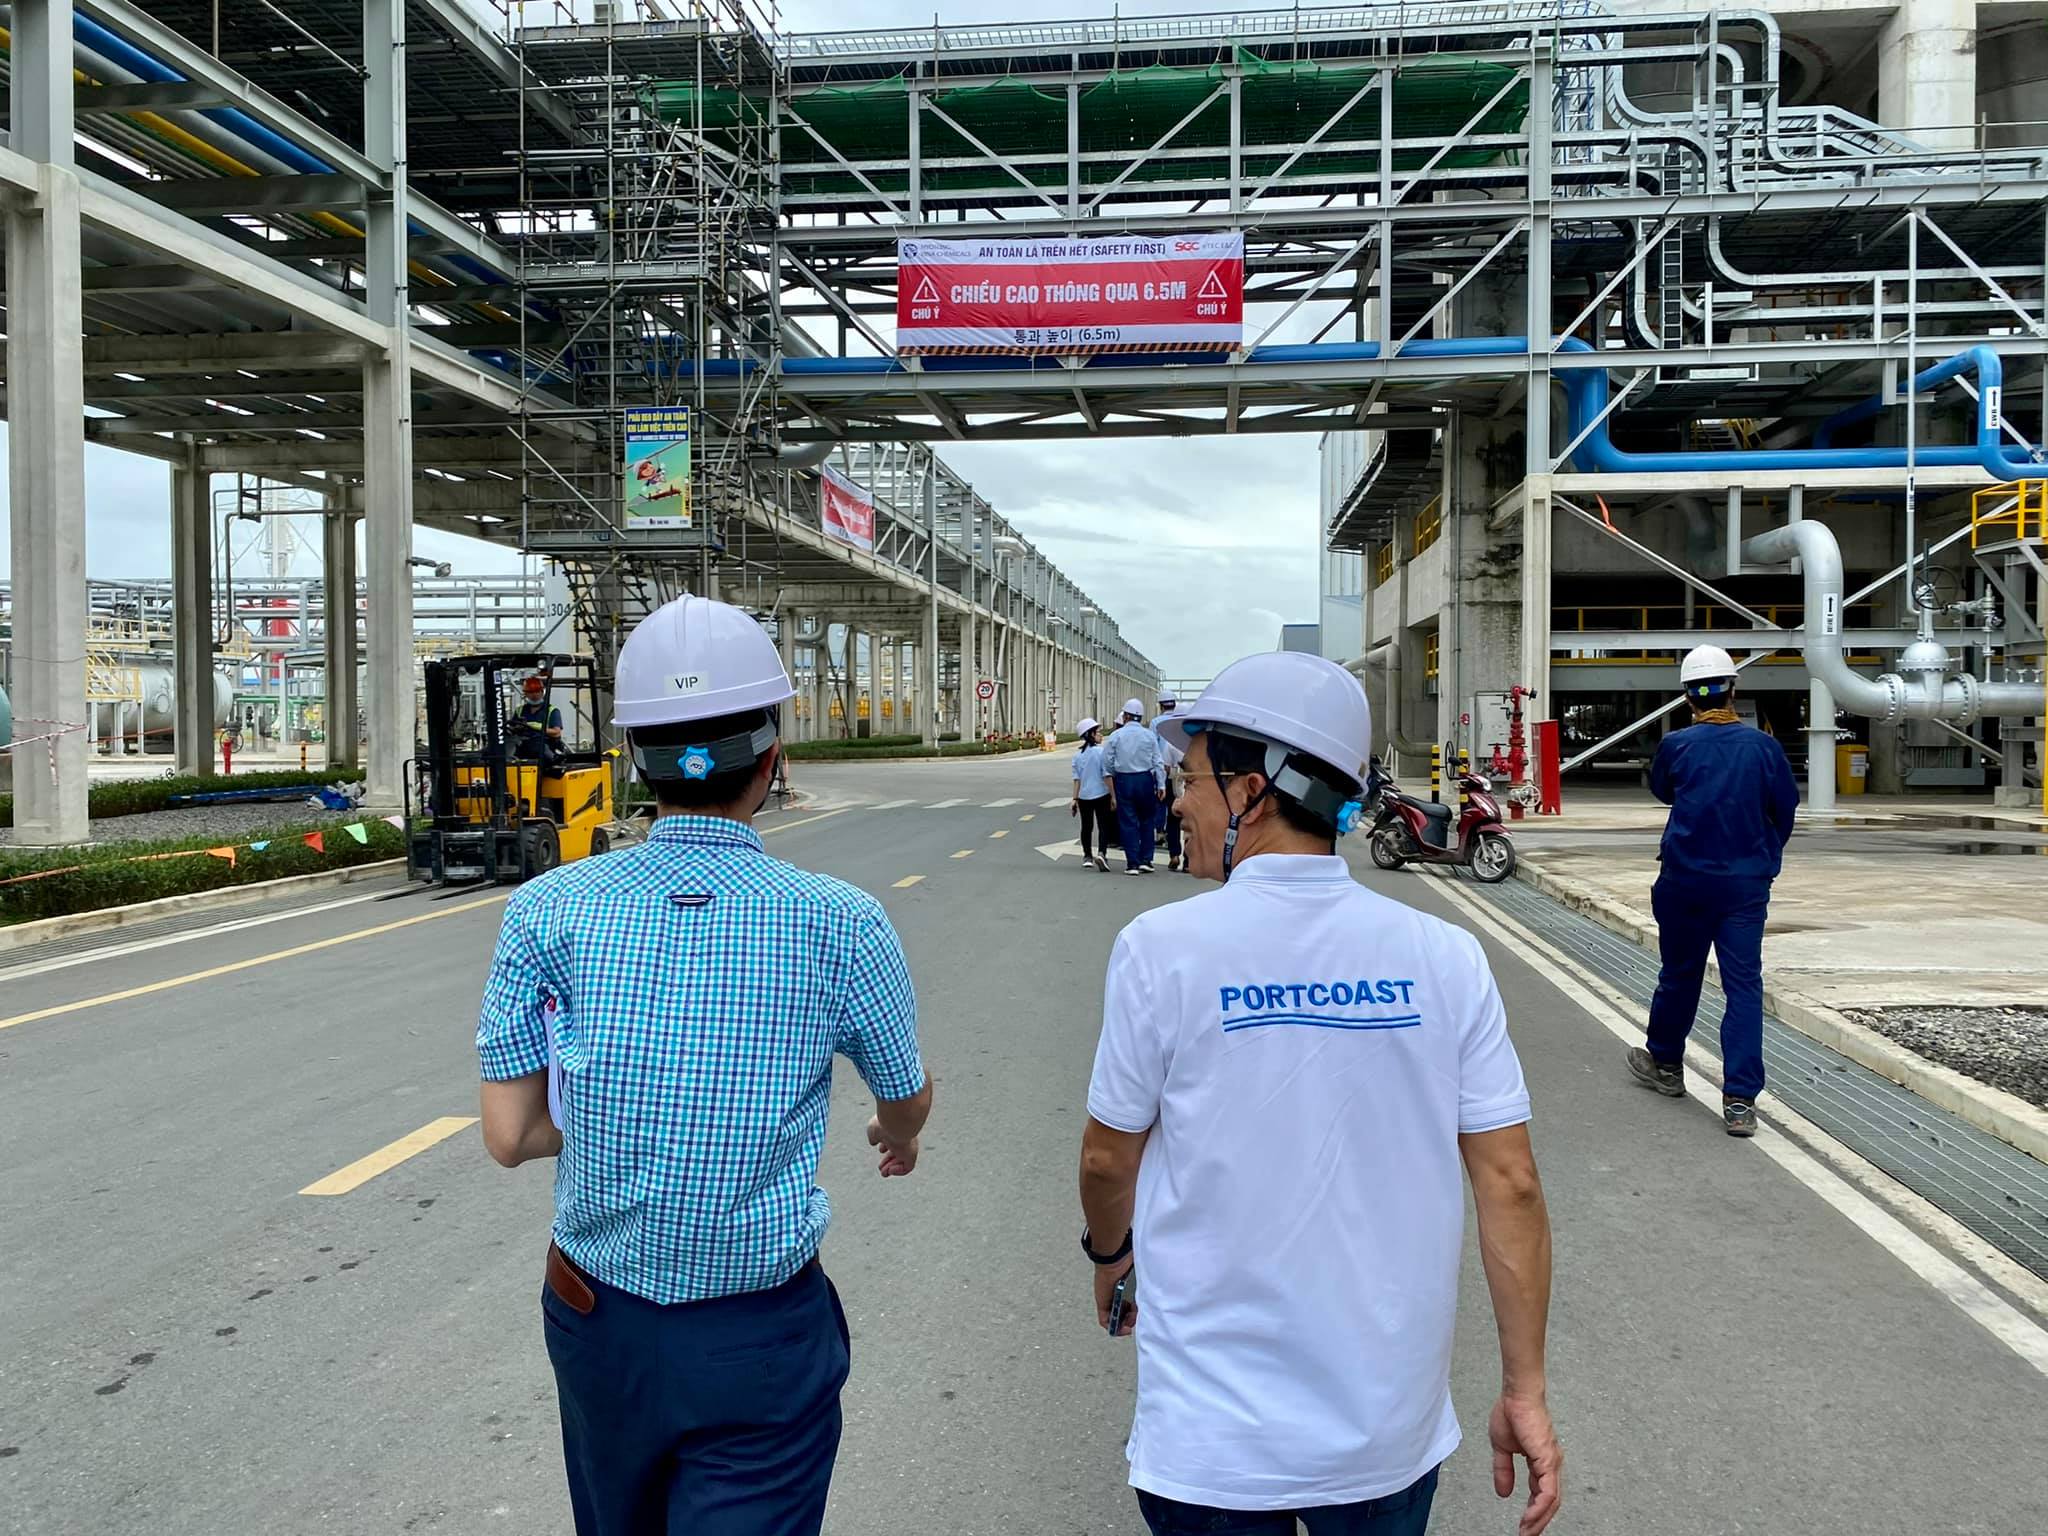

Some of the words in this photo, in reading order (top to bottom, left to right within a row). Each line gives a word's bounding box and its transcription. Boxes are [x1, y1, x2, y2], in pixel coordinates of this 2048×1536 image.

[979, 247, 993, 258] AN
[996, 245, 1023, 258] TOÀN
[1026, 245, 1038, 258] LÀ
[1041, 243, 1067, 257] TRÊN
[1091, 244, 1131, 256] (SAFETY
[1134, 243, 1166, 255] FIRST)
[1175, 241, 1200, 251] SGC
[950, 279, 1001, 304] CHIỀU
[1006, 285, 1039, 304] CAO
[1043, 281, 1100, 303] THÔNG
[1105, 283, 1139, 303] QUA
[1143, 281, 1187, 300] 6.5M
[911, 305, 931, 320] CHÚ
[933, 305, 940, 320] Ý
[1197, 301, 1218, 315] CHÚ
[1220, 301, 1228, 315] Ý
[1014, 329, 1041, 344] 통과
[1047, 328, 1072, 343] 높이
[1079, 328, 1120, 342] (6.5m)
[675, 676, 698, 689] VIP
[495, 686, 505, 745] HYUNDAI
[1220, 980, 1415, 1012] PORTCOAST
